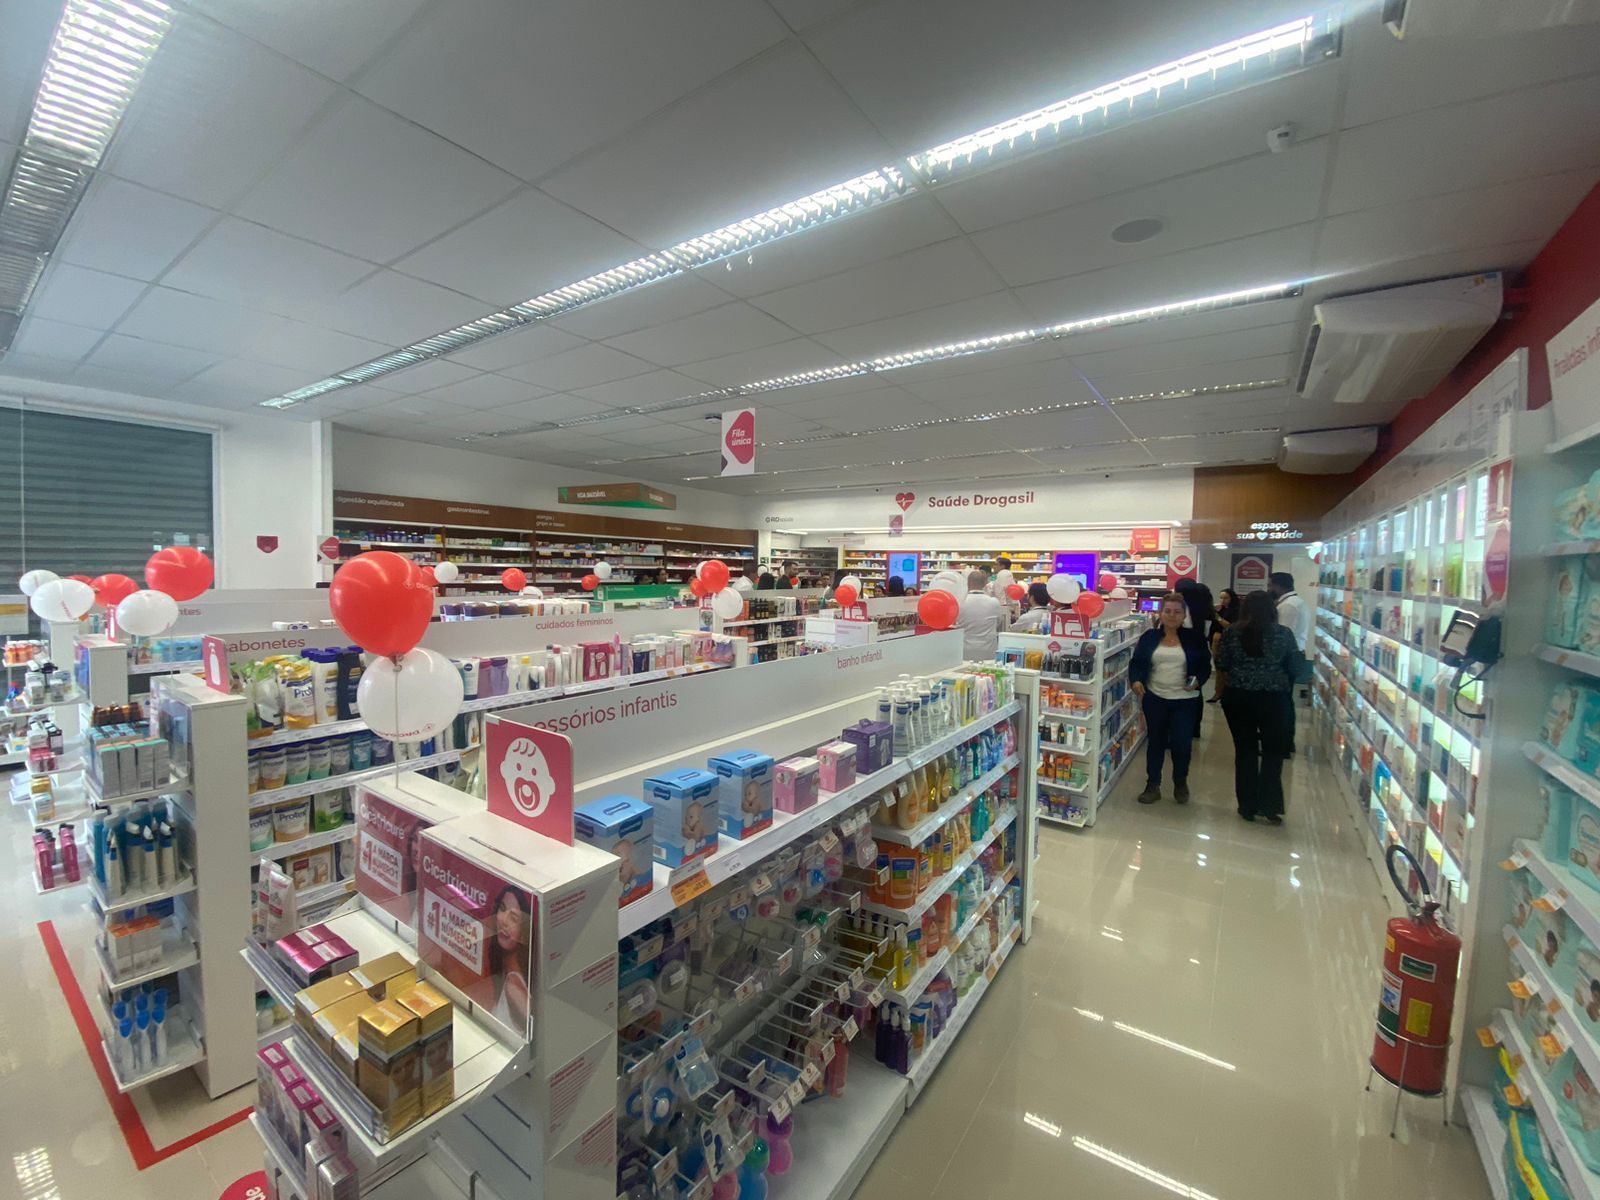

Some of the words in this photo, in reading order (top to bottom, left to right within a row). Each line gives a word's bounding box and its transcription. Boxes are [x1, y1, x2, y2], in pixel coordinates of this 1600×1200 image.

[731, 429, 746, 438] Fila
[731, 437, 752, 446] única
[928, 496, 970, 508] Saúde
[973, 491, 1034, 508] Drogasil
[1236, 532, 1255, 540] sua
[1269, 530, 1304, 540] saúde
[1250, 522, 1289, 531] espaço
[535, 619, 575, 630] cuidados
[576, 617, 614, 628] femininos
[226, 638, 306, 653] abonetes
[837, 656, 860, 670] banho
[860, 650, 883, 666] infantil
[620, 691, 677, 719] infantis
[359, 803, 406, 840] Cicatricure
[423, 855, 487, 906] Cicatricure
[449, 911, 478, 939] MARCA
[441, 920, 472, 949] NÚMERO
